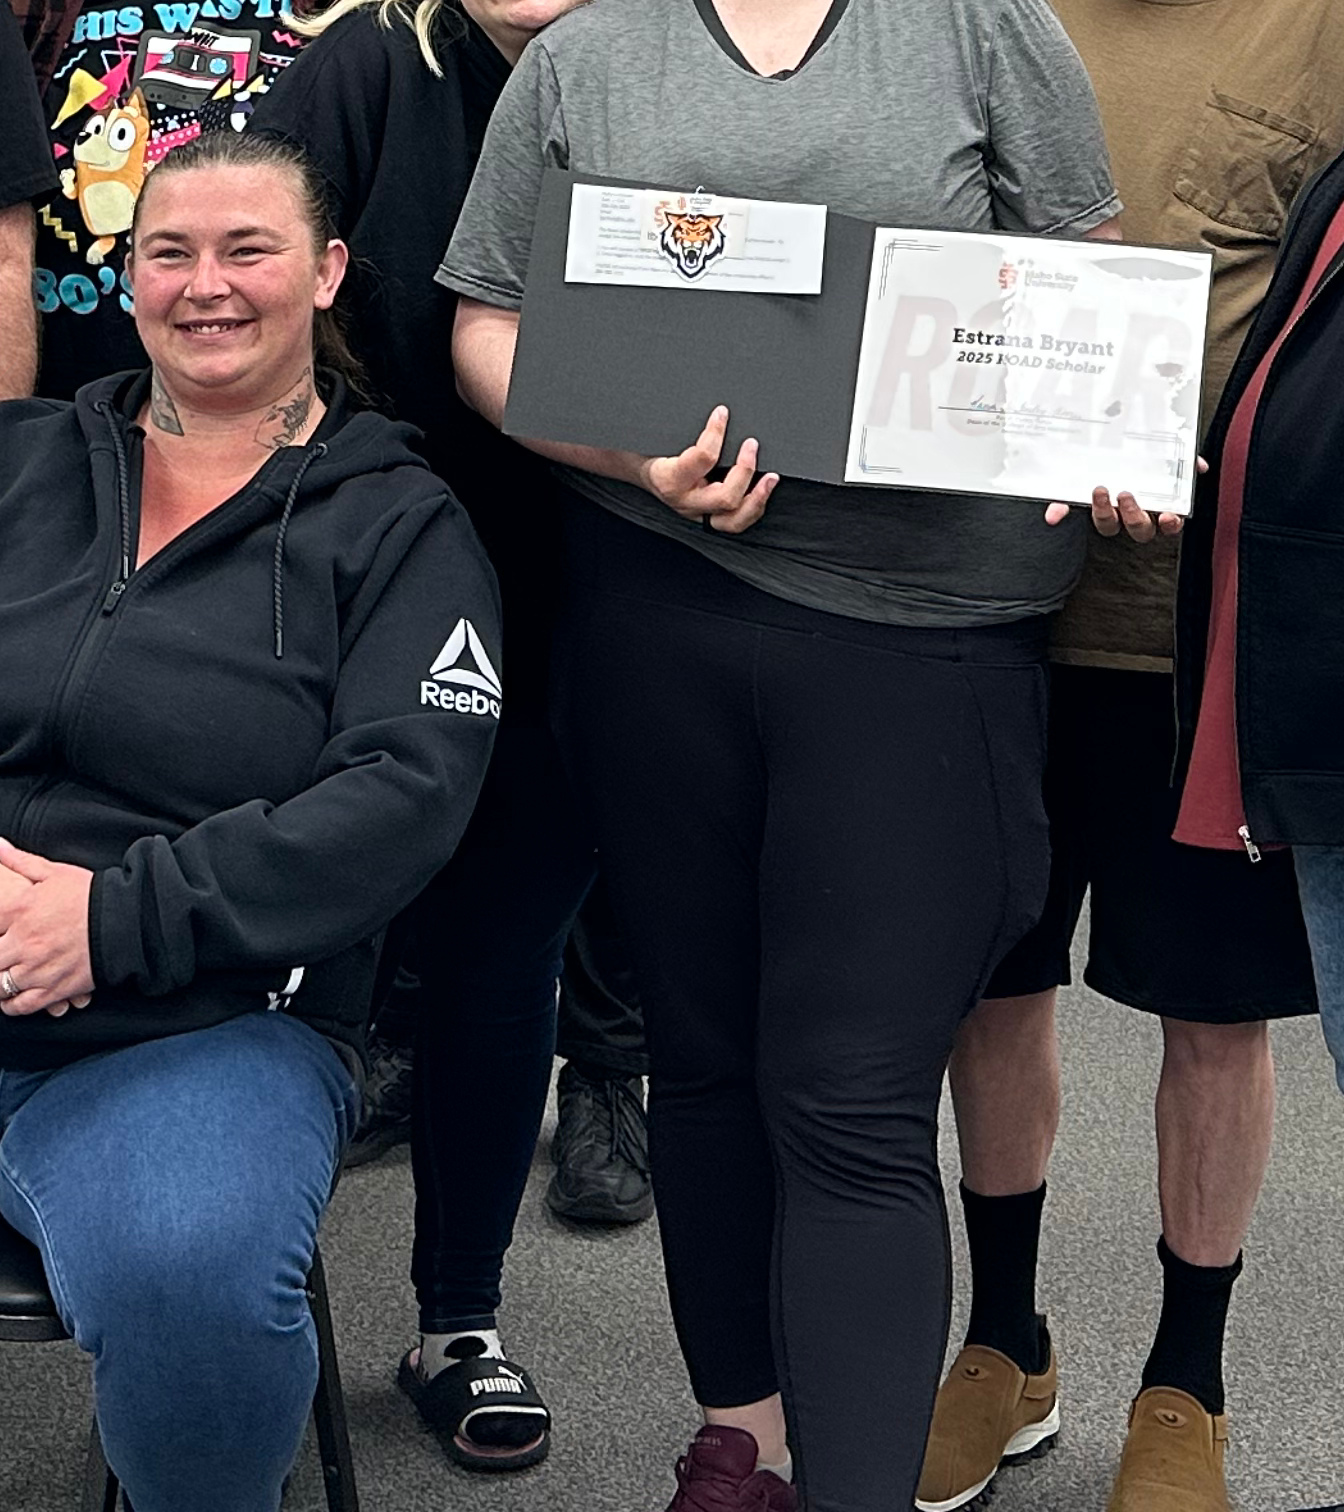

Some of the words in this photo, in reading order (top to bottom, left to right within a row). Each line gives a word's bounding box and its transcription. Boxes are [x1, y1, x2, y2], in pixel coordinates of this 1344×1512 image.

[72, 6, 144, 43] HIS
[952, 327, 1034, 349] Estrana
[1039, 334, 1115, 357] Bryant
[956, 351, 993, 364] 2025
[1045, 358, 1106, 375] Scholar
[420, 680, 501, 720] Reebo
[469, 1377, 522, 1396] PUMA
